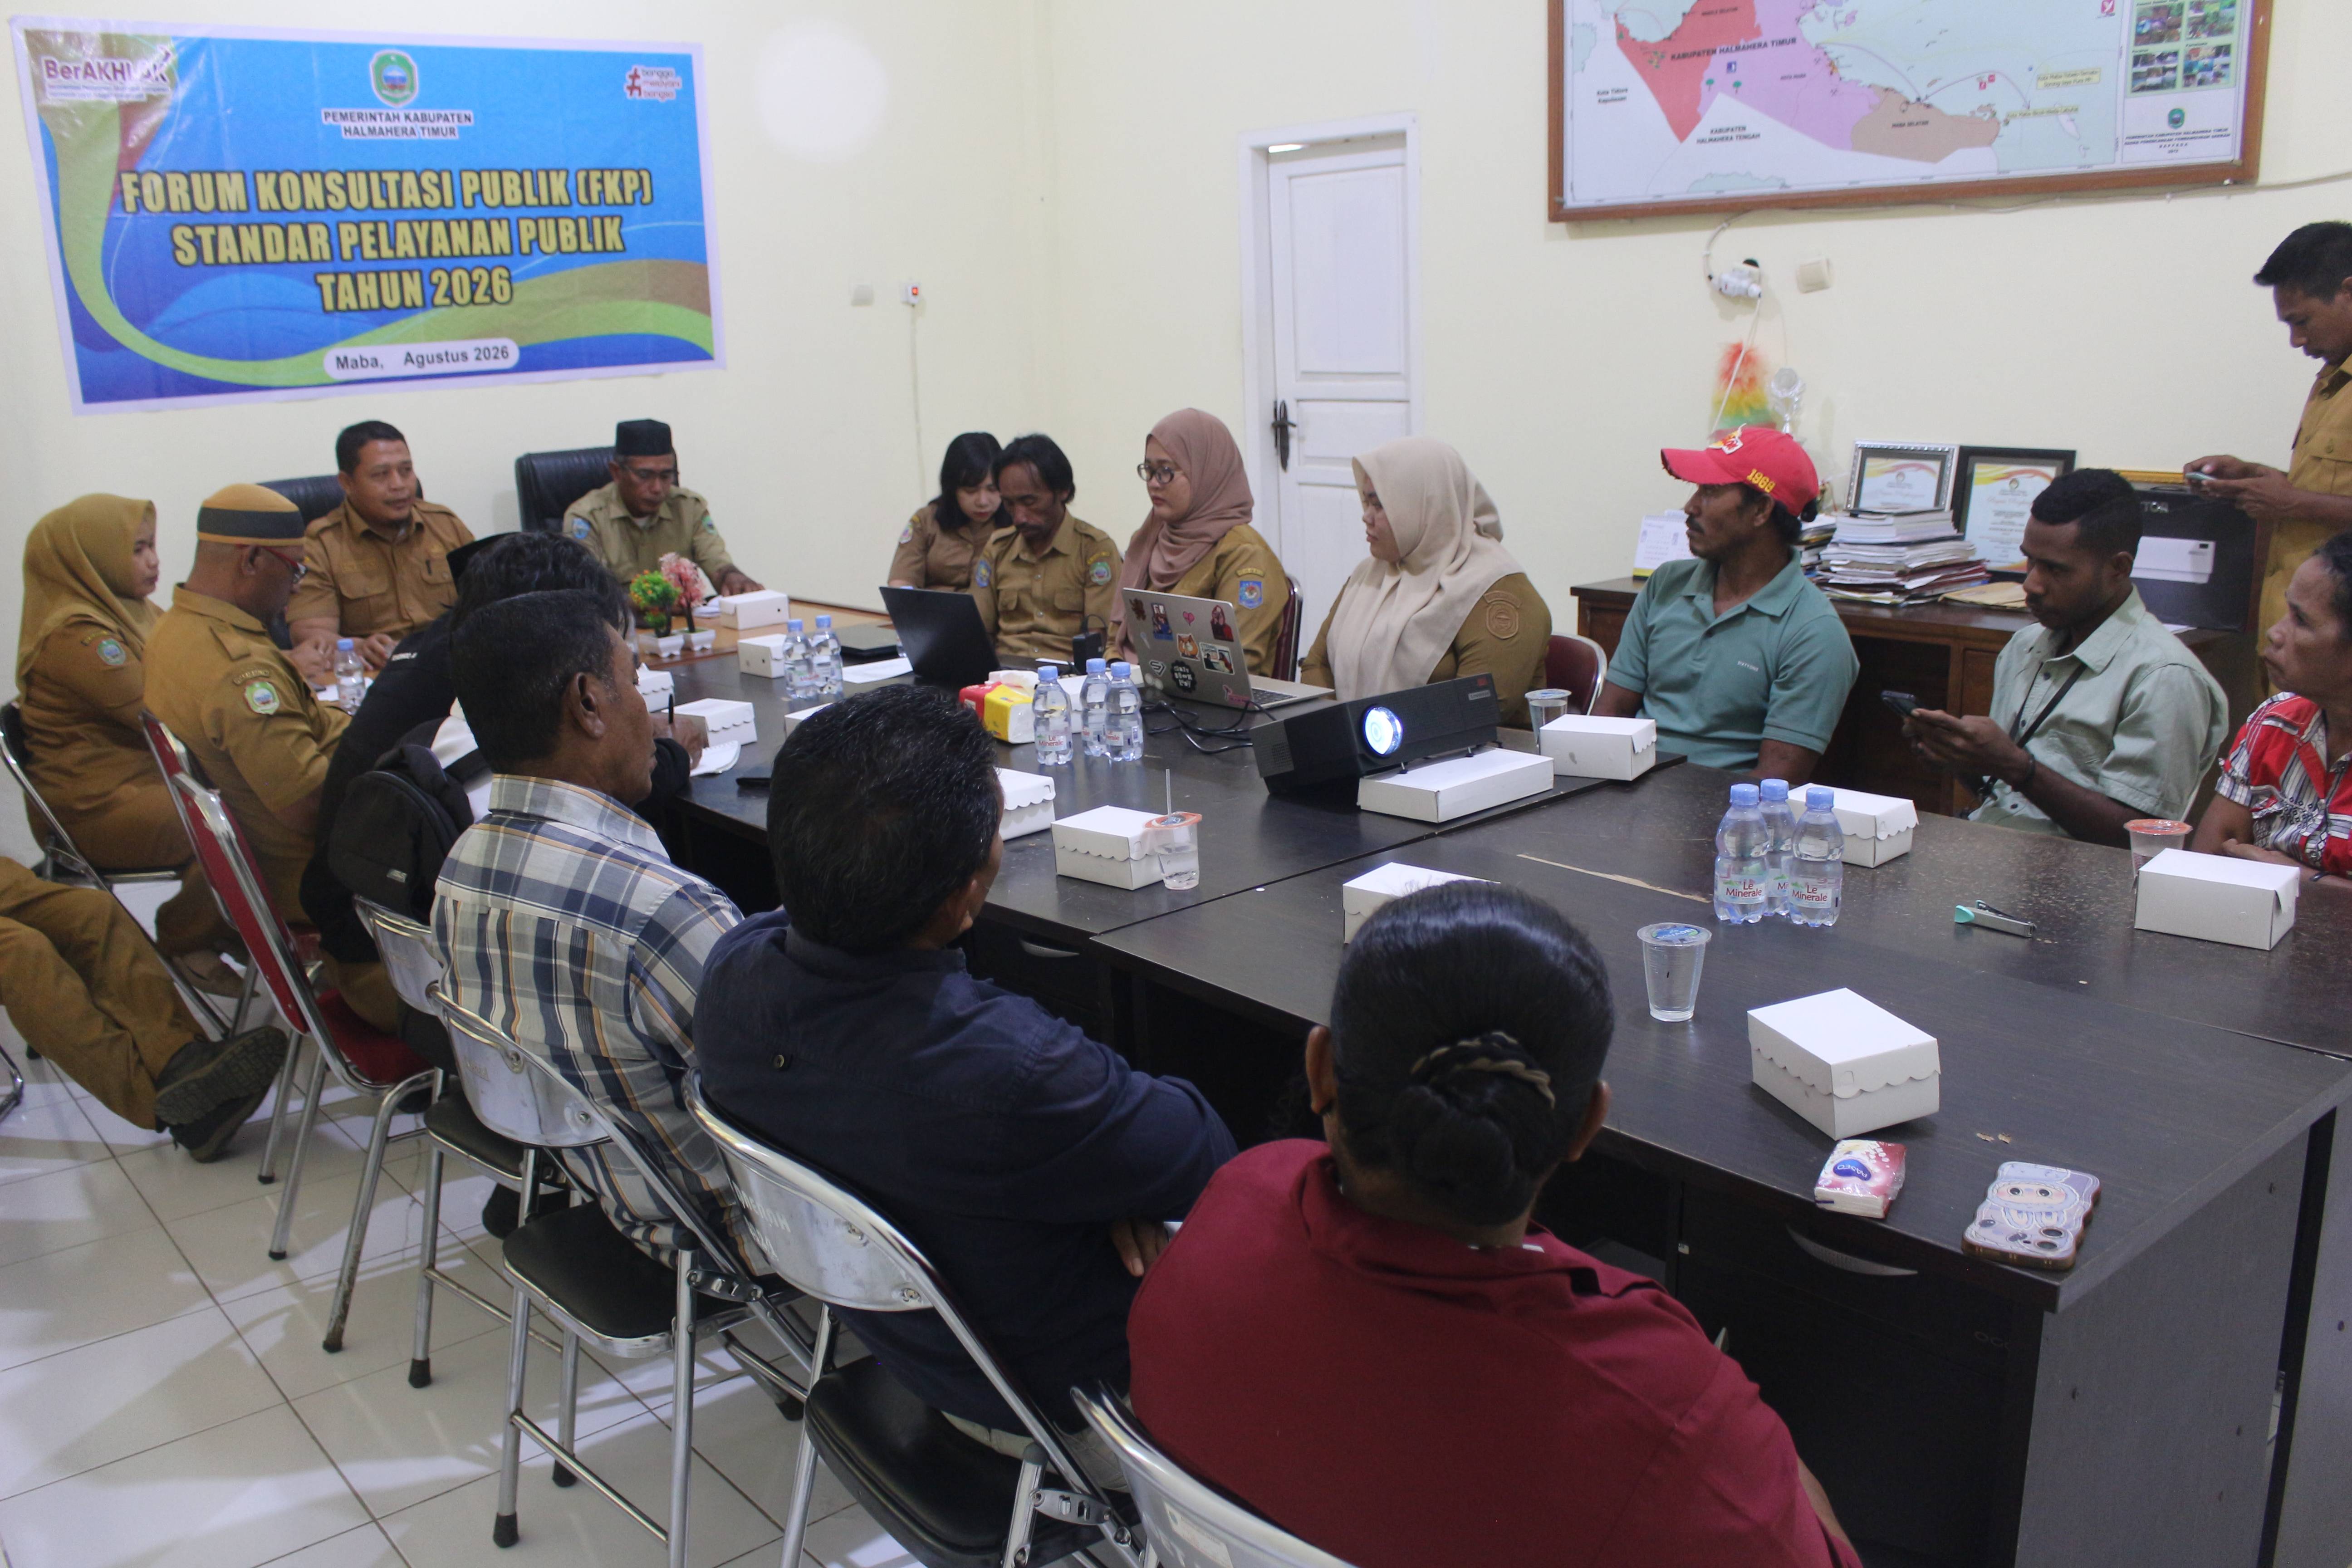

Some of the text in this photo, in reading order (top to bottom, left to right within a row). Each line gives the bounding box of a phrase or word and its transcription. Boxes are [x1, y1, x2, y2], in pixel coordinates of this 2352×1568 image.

[1671, 37, 1797, 60] KABUPATEN HALMAHERA TIMUR
[324, 111, 472, 123] PEMERINTAH KABUPATEN
[343, 126, 456, 137] HALMAHERA TIMUR
[1710, 126, 1746, 134] KABUPATEN
[120, 169, 653, 213] FORUM KONSULTASI PUBLIK (FKP)
[172, 216, 625, 266] STANDAR PELAYANAN PUBLIK
[315, 265, 513, 313] TAHUN 2026
[336, 346, 509, 370] Maba, Agustus 2026
[1726, 887, 1762, 897] Minerale
[1743, 882, 1754, 890] Le
[1807, 885, 1817, 894] Le
[1792, 889, 1828, 902] Minerale
[1837, 1163, 1868, 1178] PASEO
